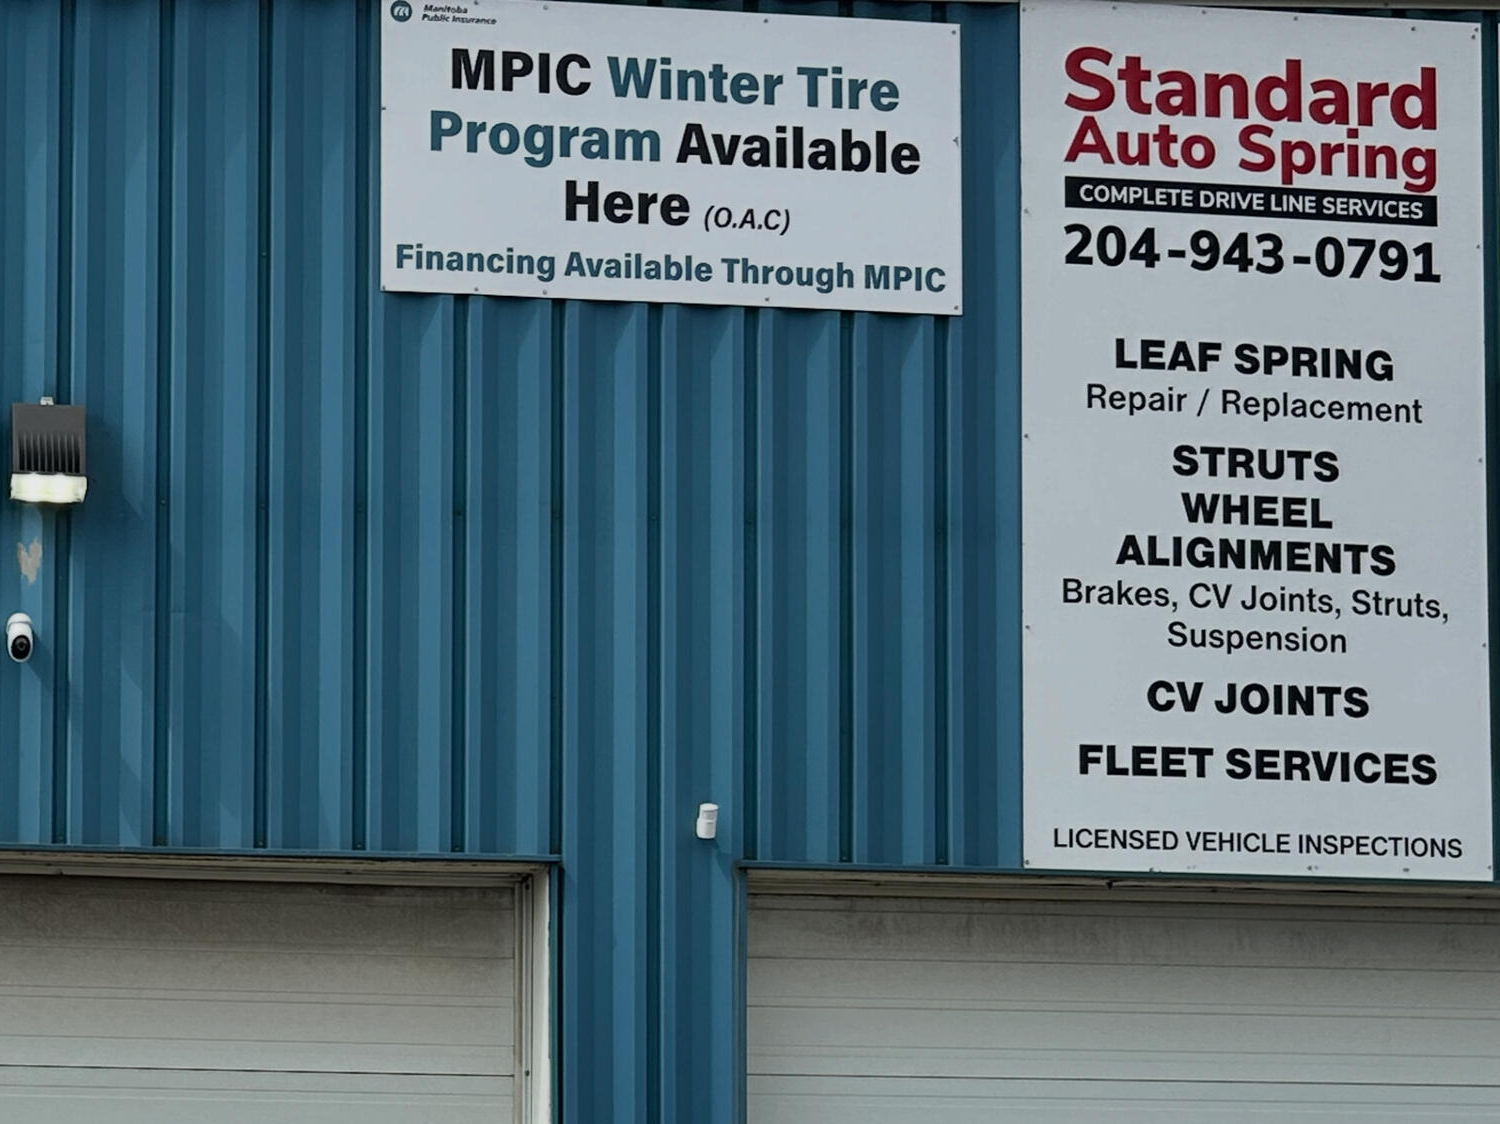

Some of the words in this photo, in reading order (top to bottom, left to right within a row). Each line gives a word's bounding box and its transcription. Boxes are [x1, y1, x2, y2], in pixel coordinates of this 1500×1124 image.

[421, 13, 451, 23] Public
[451, 15, 498, 25] Insurance
[423, 4, 468, 14] Manitoba
[451, 47, 592, 96] MPIC
[606, 55, 784, 106] Winter
[796, 66, 900, 112] Tire
[1064, 46, 1437, 131] Standard
[430, 109, 661, 169] Program
[675, 122, 921, 175] Available
[1063, 115, 1216, 170] Auto
[1238, 123, 1437, 194] Spring
[565, 179, 690, 227] Here
[704, 205, 790, 236] (O.A.C)
[1079, 183, 1194, 207] COMPLETE
[1199, 190, 1265, 211] DRIVE
[1270, 193, 1317, 214] LINE
[1322, 196, 1423, 220] SERVICES
[396, 243, 556, 283] Financing
[563, 251, 713, 283] Available
[720, 257, 855, 294] Through
[864, 264, 946, 293] MPIC
[1063, 223, 1442, 284] 204-943-0791
[1115, 337, 1222, 373] LEAF
[1234, 343, 1394, 382] SPRING
[1087, 383, 1188, 417] Repair
[1196, 387, 1210, 418] /
[1221, 389, 1423, 424] Replacement
[1172, 444, 1340, 483] STRUTS
[1180, 492, 1333, 530] WHEEL
[1115, 534, 1396, 577] ALIGNMENTS
[1062, 577, 1178, 613] Brakes,
[1188, 582, 1233, 609] CV
[1240, 585, 1341, 620] Joints,
[1351, 589, 1449, 624] Struts,
[1167, 621, 1347, 655] Suspension
[1146, 680, 1204, 713] CV
[1214, 682, 1370, 719] JOINTS
[1079, 744, 1214, 779] FLEET
[1225, 747, 1438, 786] SERVICES
[1053, 827, 1179, 851] LICENSED
[1185, 831, 1291, 854] VEHICLE
[1298, 834, 1463, 859] INSPECTIONS
